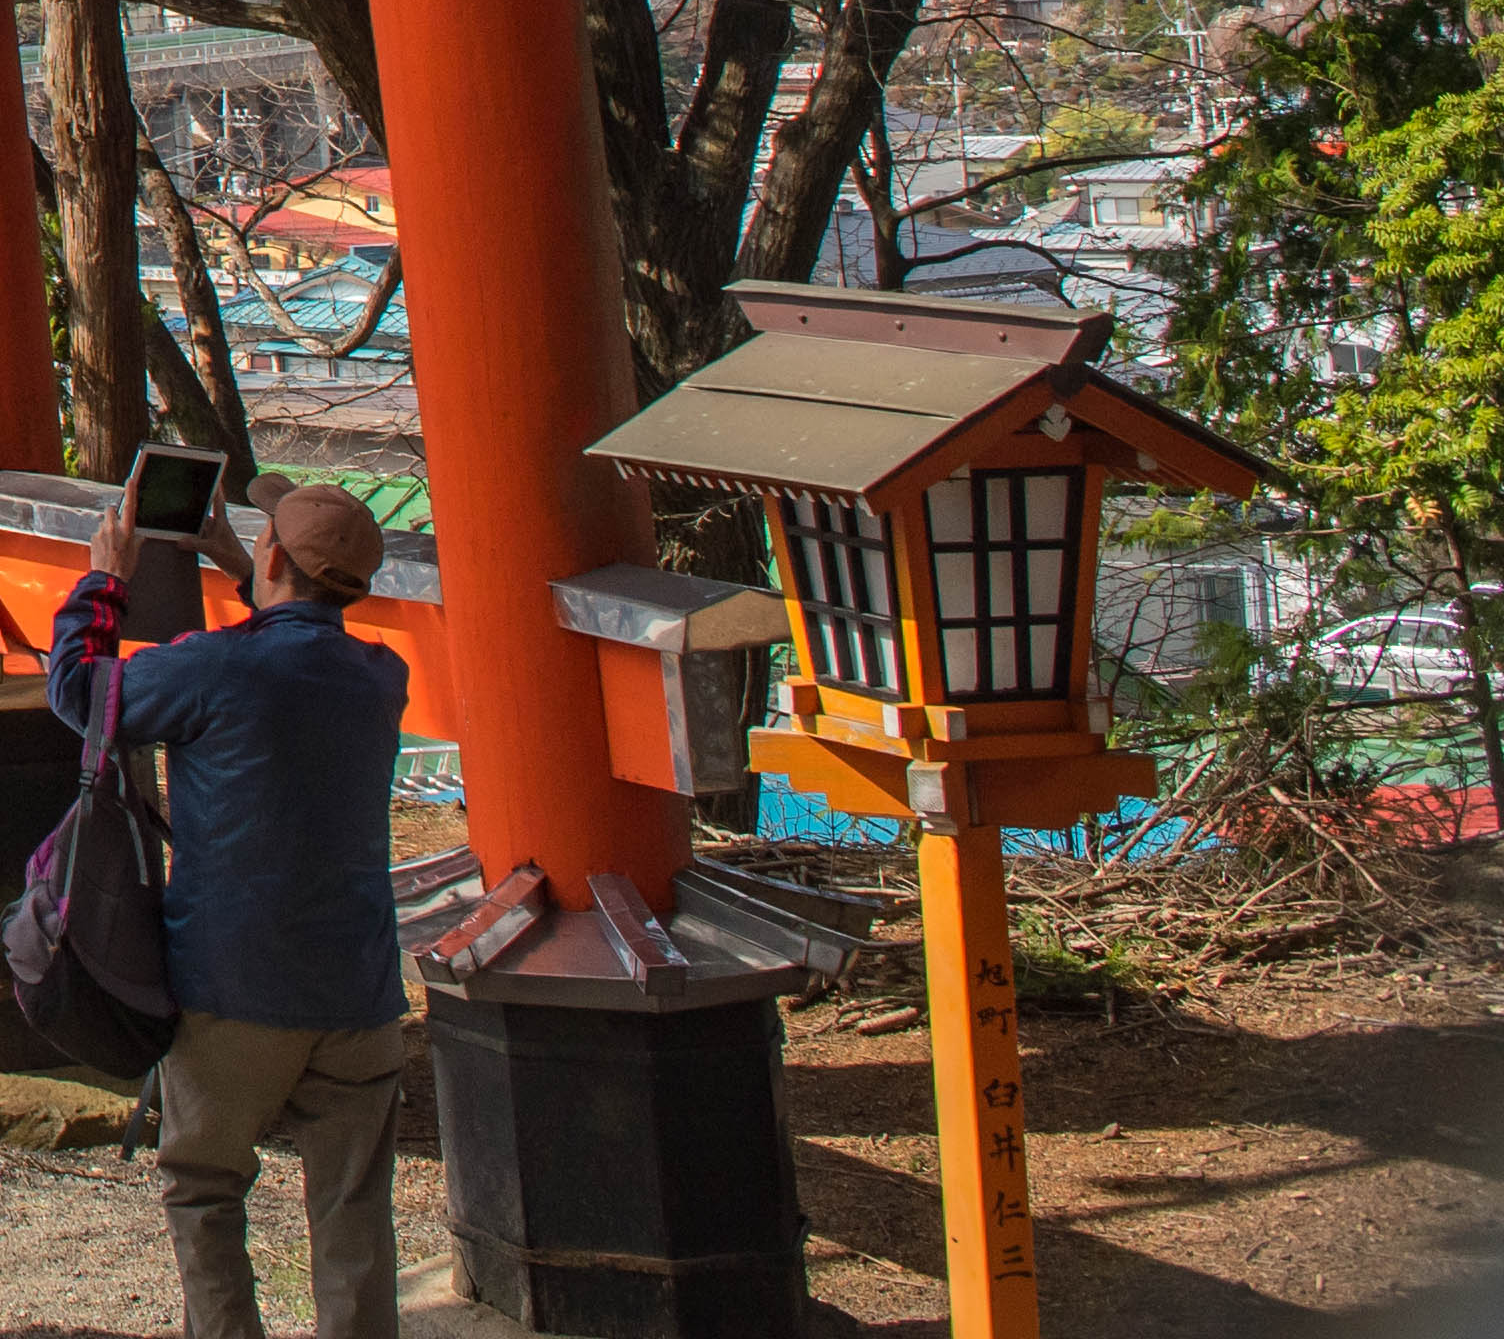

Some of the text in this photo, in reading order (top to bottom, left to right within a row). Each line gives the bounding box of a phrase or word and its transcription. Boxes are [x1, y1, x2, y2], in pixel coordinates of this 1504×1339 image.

[975, 957, 1033, 1281] 旭町 臼井仁三
